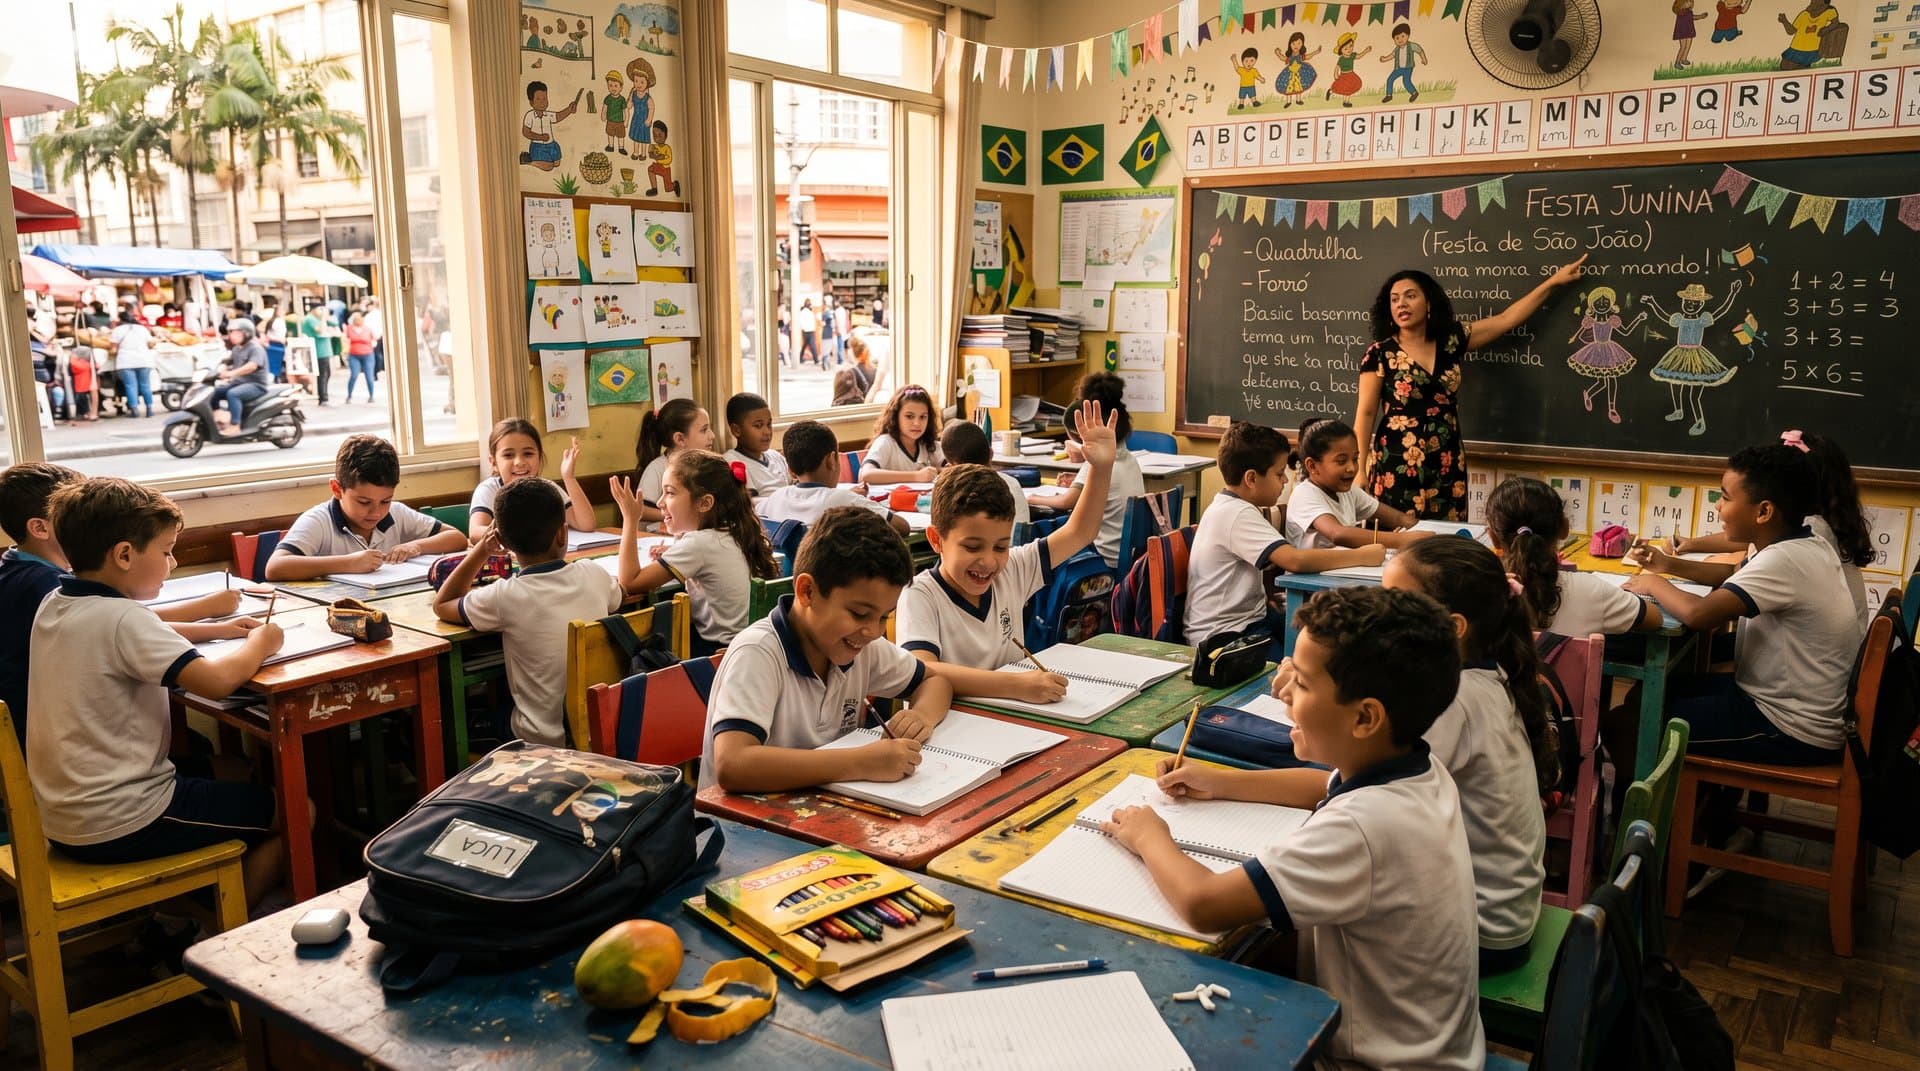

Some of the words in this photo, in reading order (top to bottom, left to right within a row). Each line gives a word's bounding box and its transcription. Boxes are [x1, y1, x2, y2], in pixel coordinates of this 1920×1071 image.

[1192, 130, 1205, 146] A
[1218, 128, 1230, 144] B
[1243, 126, 1257, 142] C
[1269, 124, 1282, 141] D
[1296, 122, 1309, 139] E
[1324, 120, 1336, 137] F
[1350, 118, 1366, 135] G
[1380, 115, 1395, 133] H
[1415, 113, 1420, 132] I
[1442, 110, 1455, 129] J
[1473, 108, 1489, 127] K
[1508, 106, 1521, 125] L
[1546, 101, 1566, 122] M
[1583, 99, 1601, 119] N
[1619, 95, 1640, 116] O
[1658, 92, 1677, 113] P
[1696, 88, 1719, 110] Q
[1738, 85, 1759, 107] R
[1780, 81, 1800, 103] S
[1823, 78, 1844, 100] R
[1867, 73, 1888, 97] S
[1270, 145, 1280, 160] d
[1584, 128, 1600, 139] n
[1526, 187, 1600, 218] FESTA
[1610, 184, 1714, 217] JUNINA
[1422, 228, 1489, 257] (Festa
[1498, 230, 1523, 252] de
[1533, 227, 1577, 251] São
[1585, 220, 1652, 252] João)
[1789, 270, 1802, 291] 1
[1808, 274, 1823, 289] +
[1829, 271, 1845, 290] 2
[1853, 279, 1867, 288] =
[1879, 270, 1895, 290] 4
[1784, 298, 1800, 316] 3
[1806, 300, 1823, 315] +
[1828, 298, 1845, 316] 5
[1853, 303, 1868, 313] =
[1879, 298, 1900, 318] 3
[1783, 327, 1799, 346] 3
[1806, 330, 1819, 345] +
[1828, 327, 1843, 347] 3
[1850, 336, 1864, 346] =
[1243, 353, 1269, 373] que
[1781, 359, 1798, 381] 5
[1826, 363, 1842, 384] 6
[1849, 371, 1864, 382] =
[1572, 498, 1580, 510] S
[1602, 501, 1611, 514] L
[1653, 506, 1666, 518] M
[1671, 508, 1682, 520] M
[1706, 511, 1715, 523] B
[462, 837, 517, 865] LUCA
